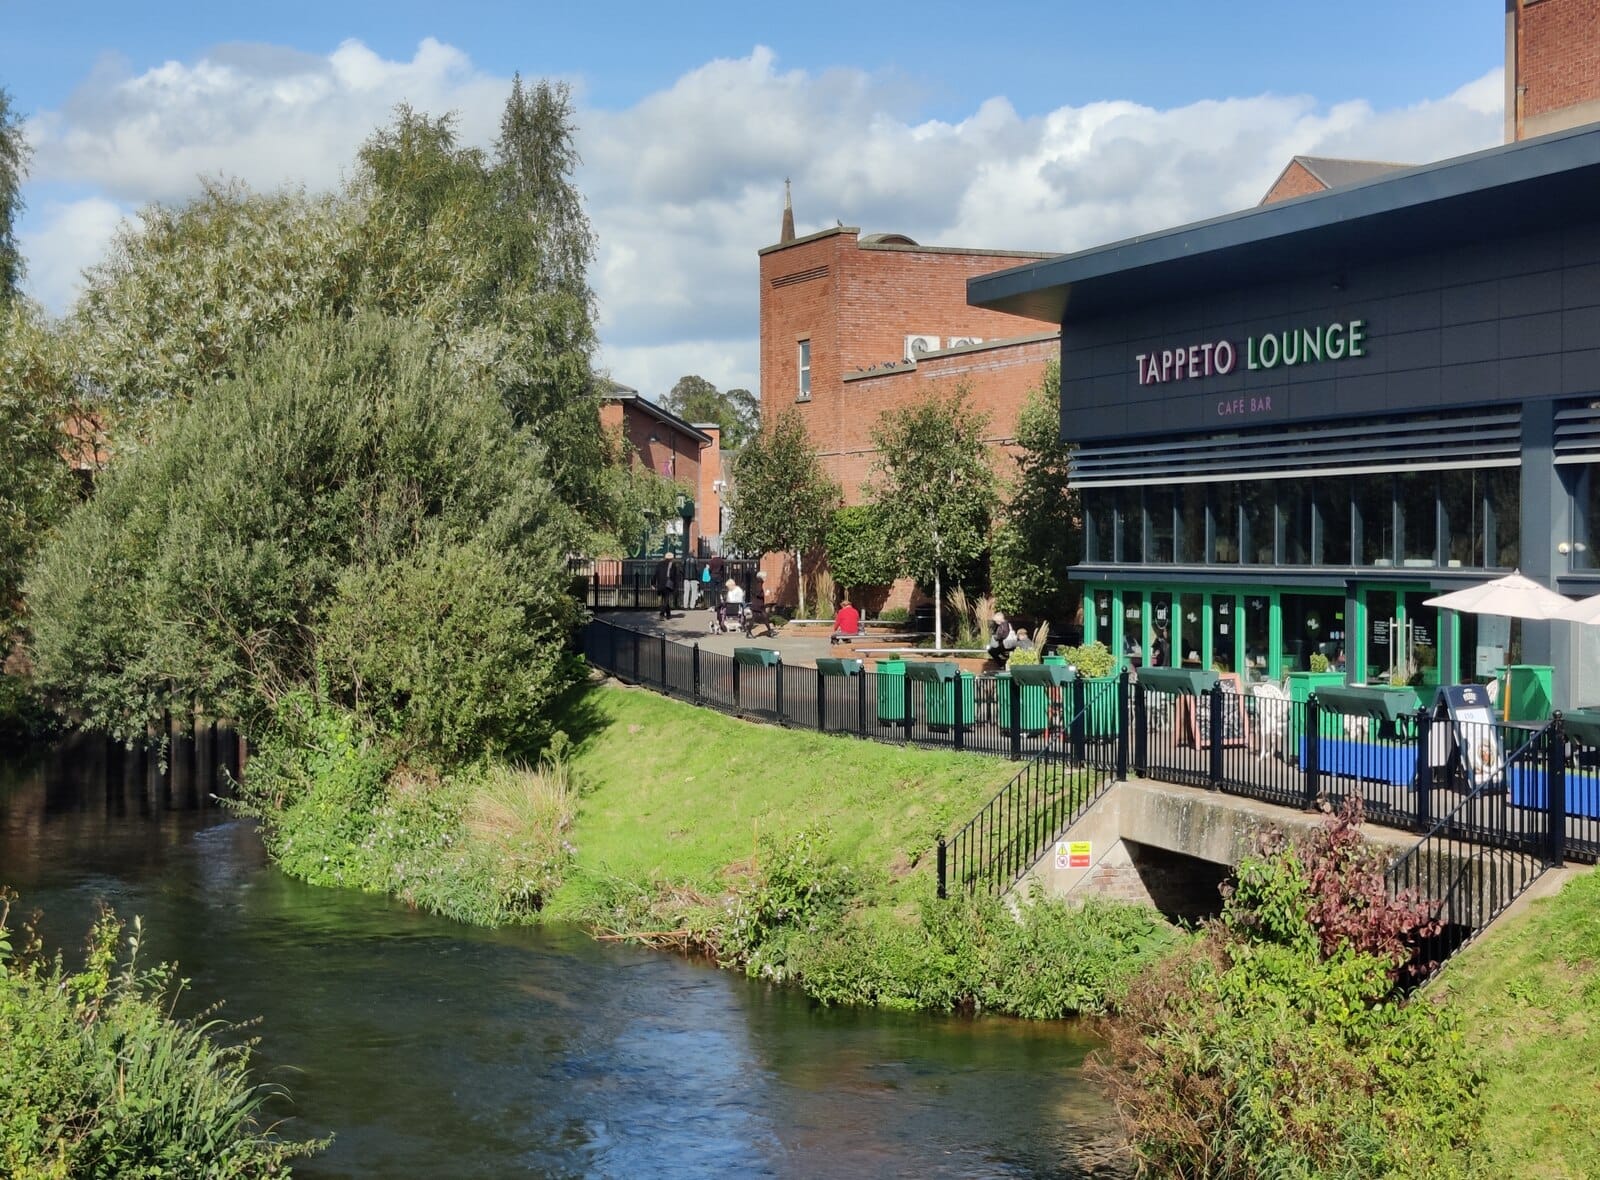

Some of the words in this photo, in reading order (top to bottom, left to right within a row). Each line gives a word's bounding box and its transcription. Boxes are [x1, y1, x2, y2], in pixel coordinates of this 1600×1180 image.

[1136, 341, 1235, 385] TAPPETO
[1247, 319, 1364, 370] LOUNGE
[1217, 399, 1245, 416] CAFE
[1250, 396, 1272, 413] BAR
